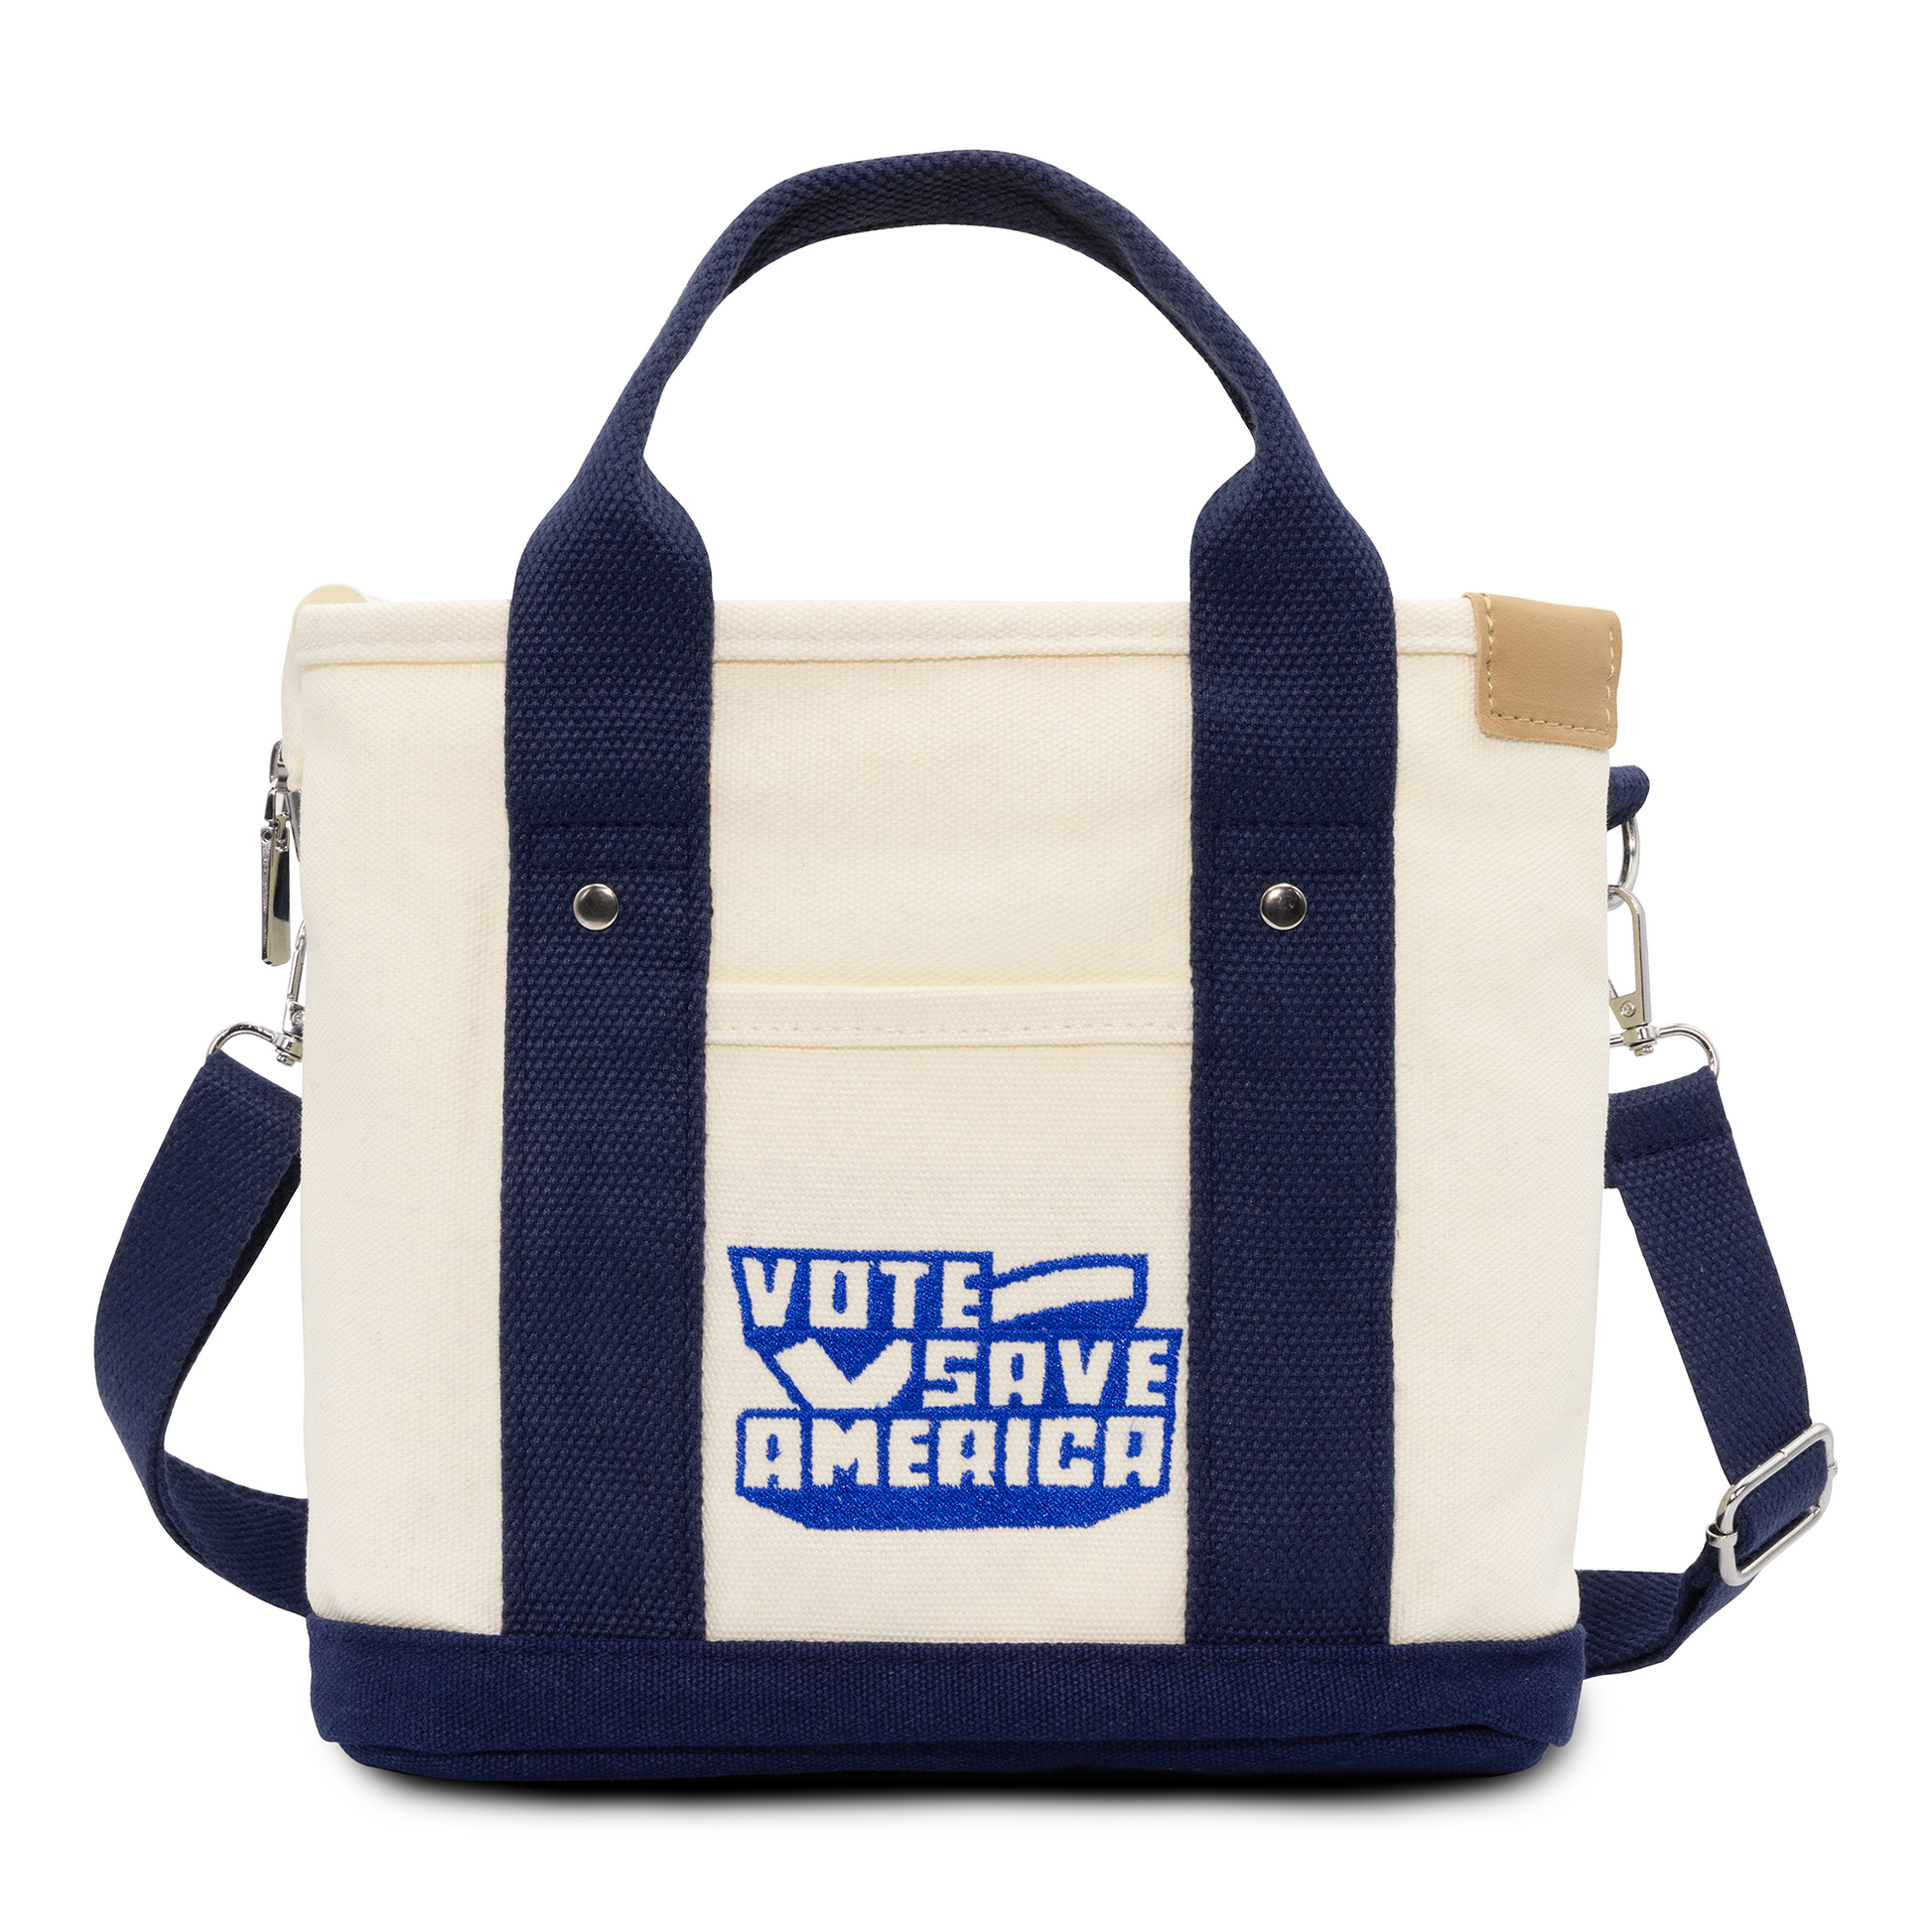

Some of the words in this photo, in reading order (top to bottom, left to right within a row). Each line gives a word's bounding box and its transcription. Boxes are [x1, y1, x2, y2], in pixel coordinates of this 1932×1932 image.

[742, 1256, 981, 1328] VOTE
[922, 1338, 1170, 1408] SAVE
[744, 1416, 1166, 1488] AMERICA
